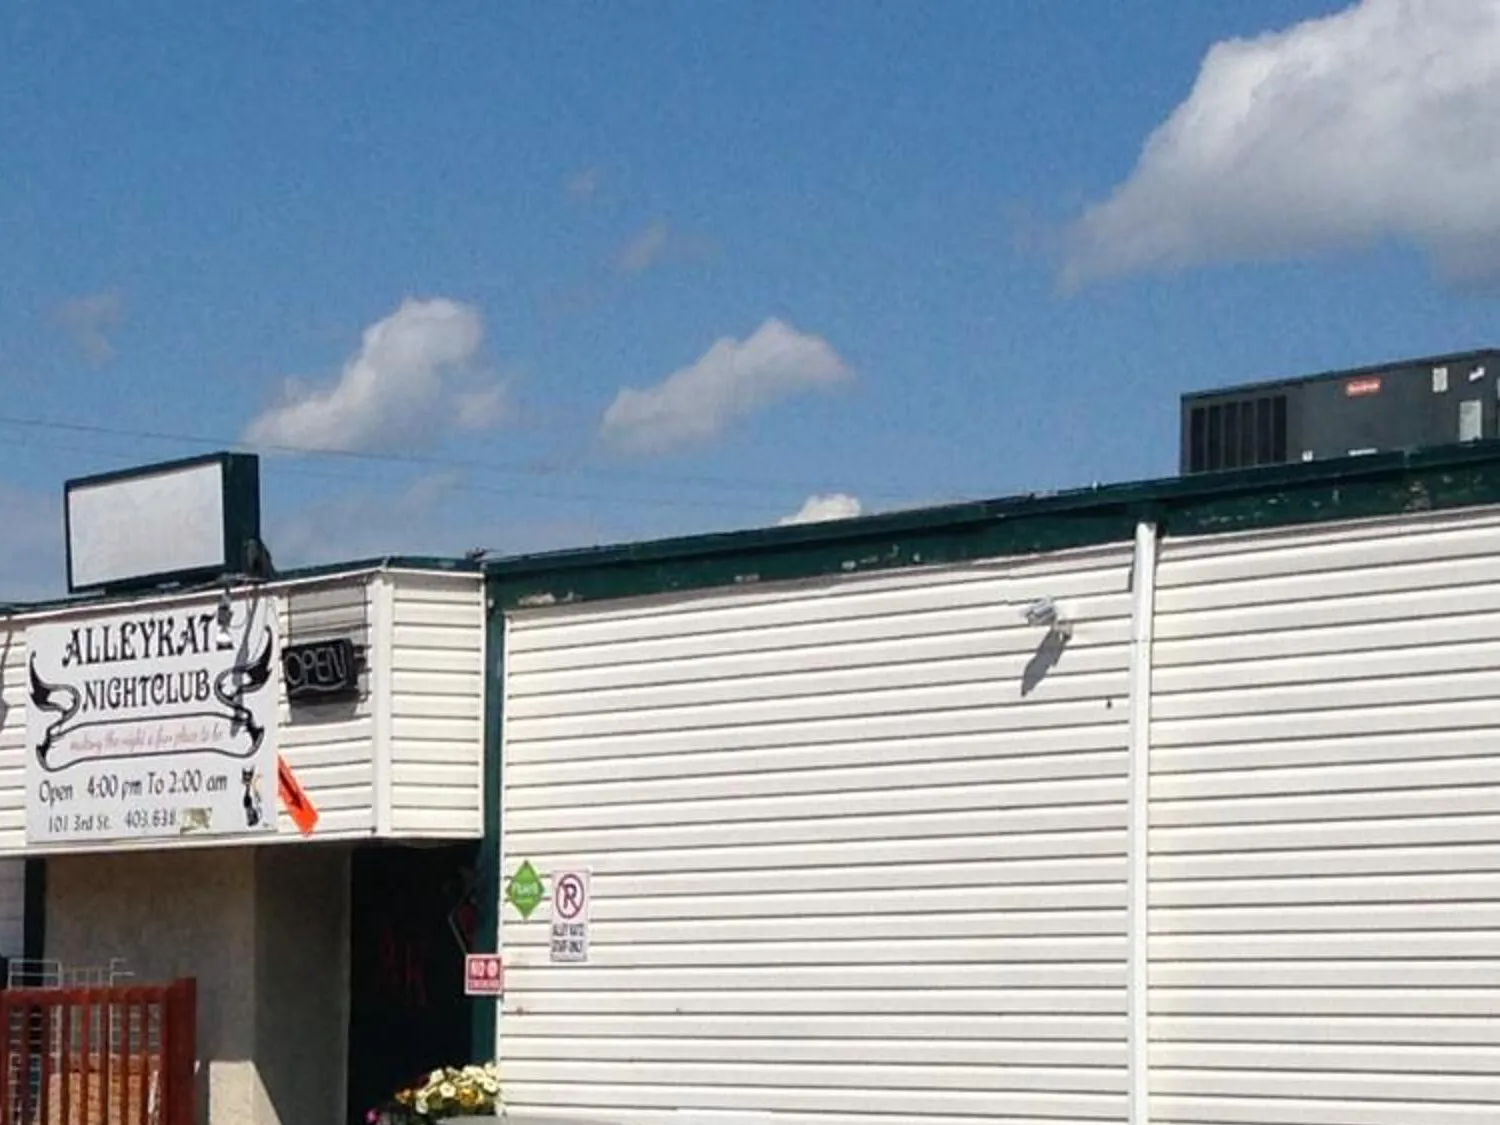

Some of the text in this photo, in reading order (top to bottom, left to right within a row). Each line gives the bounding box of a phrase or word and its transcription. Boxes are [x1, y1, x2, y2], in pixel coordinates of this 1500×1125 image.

[62, 613, 234, 668] ALLEYKAT
[284, 643, 346, 686] OPEN
[82, 668, 211, 712] NIGHTCLUB
[38, 768, 228, 807] Open 4:00 pm To 2:00 am
[73, 812, 94, 832] 3rd
